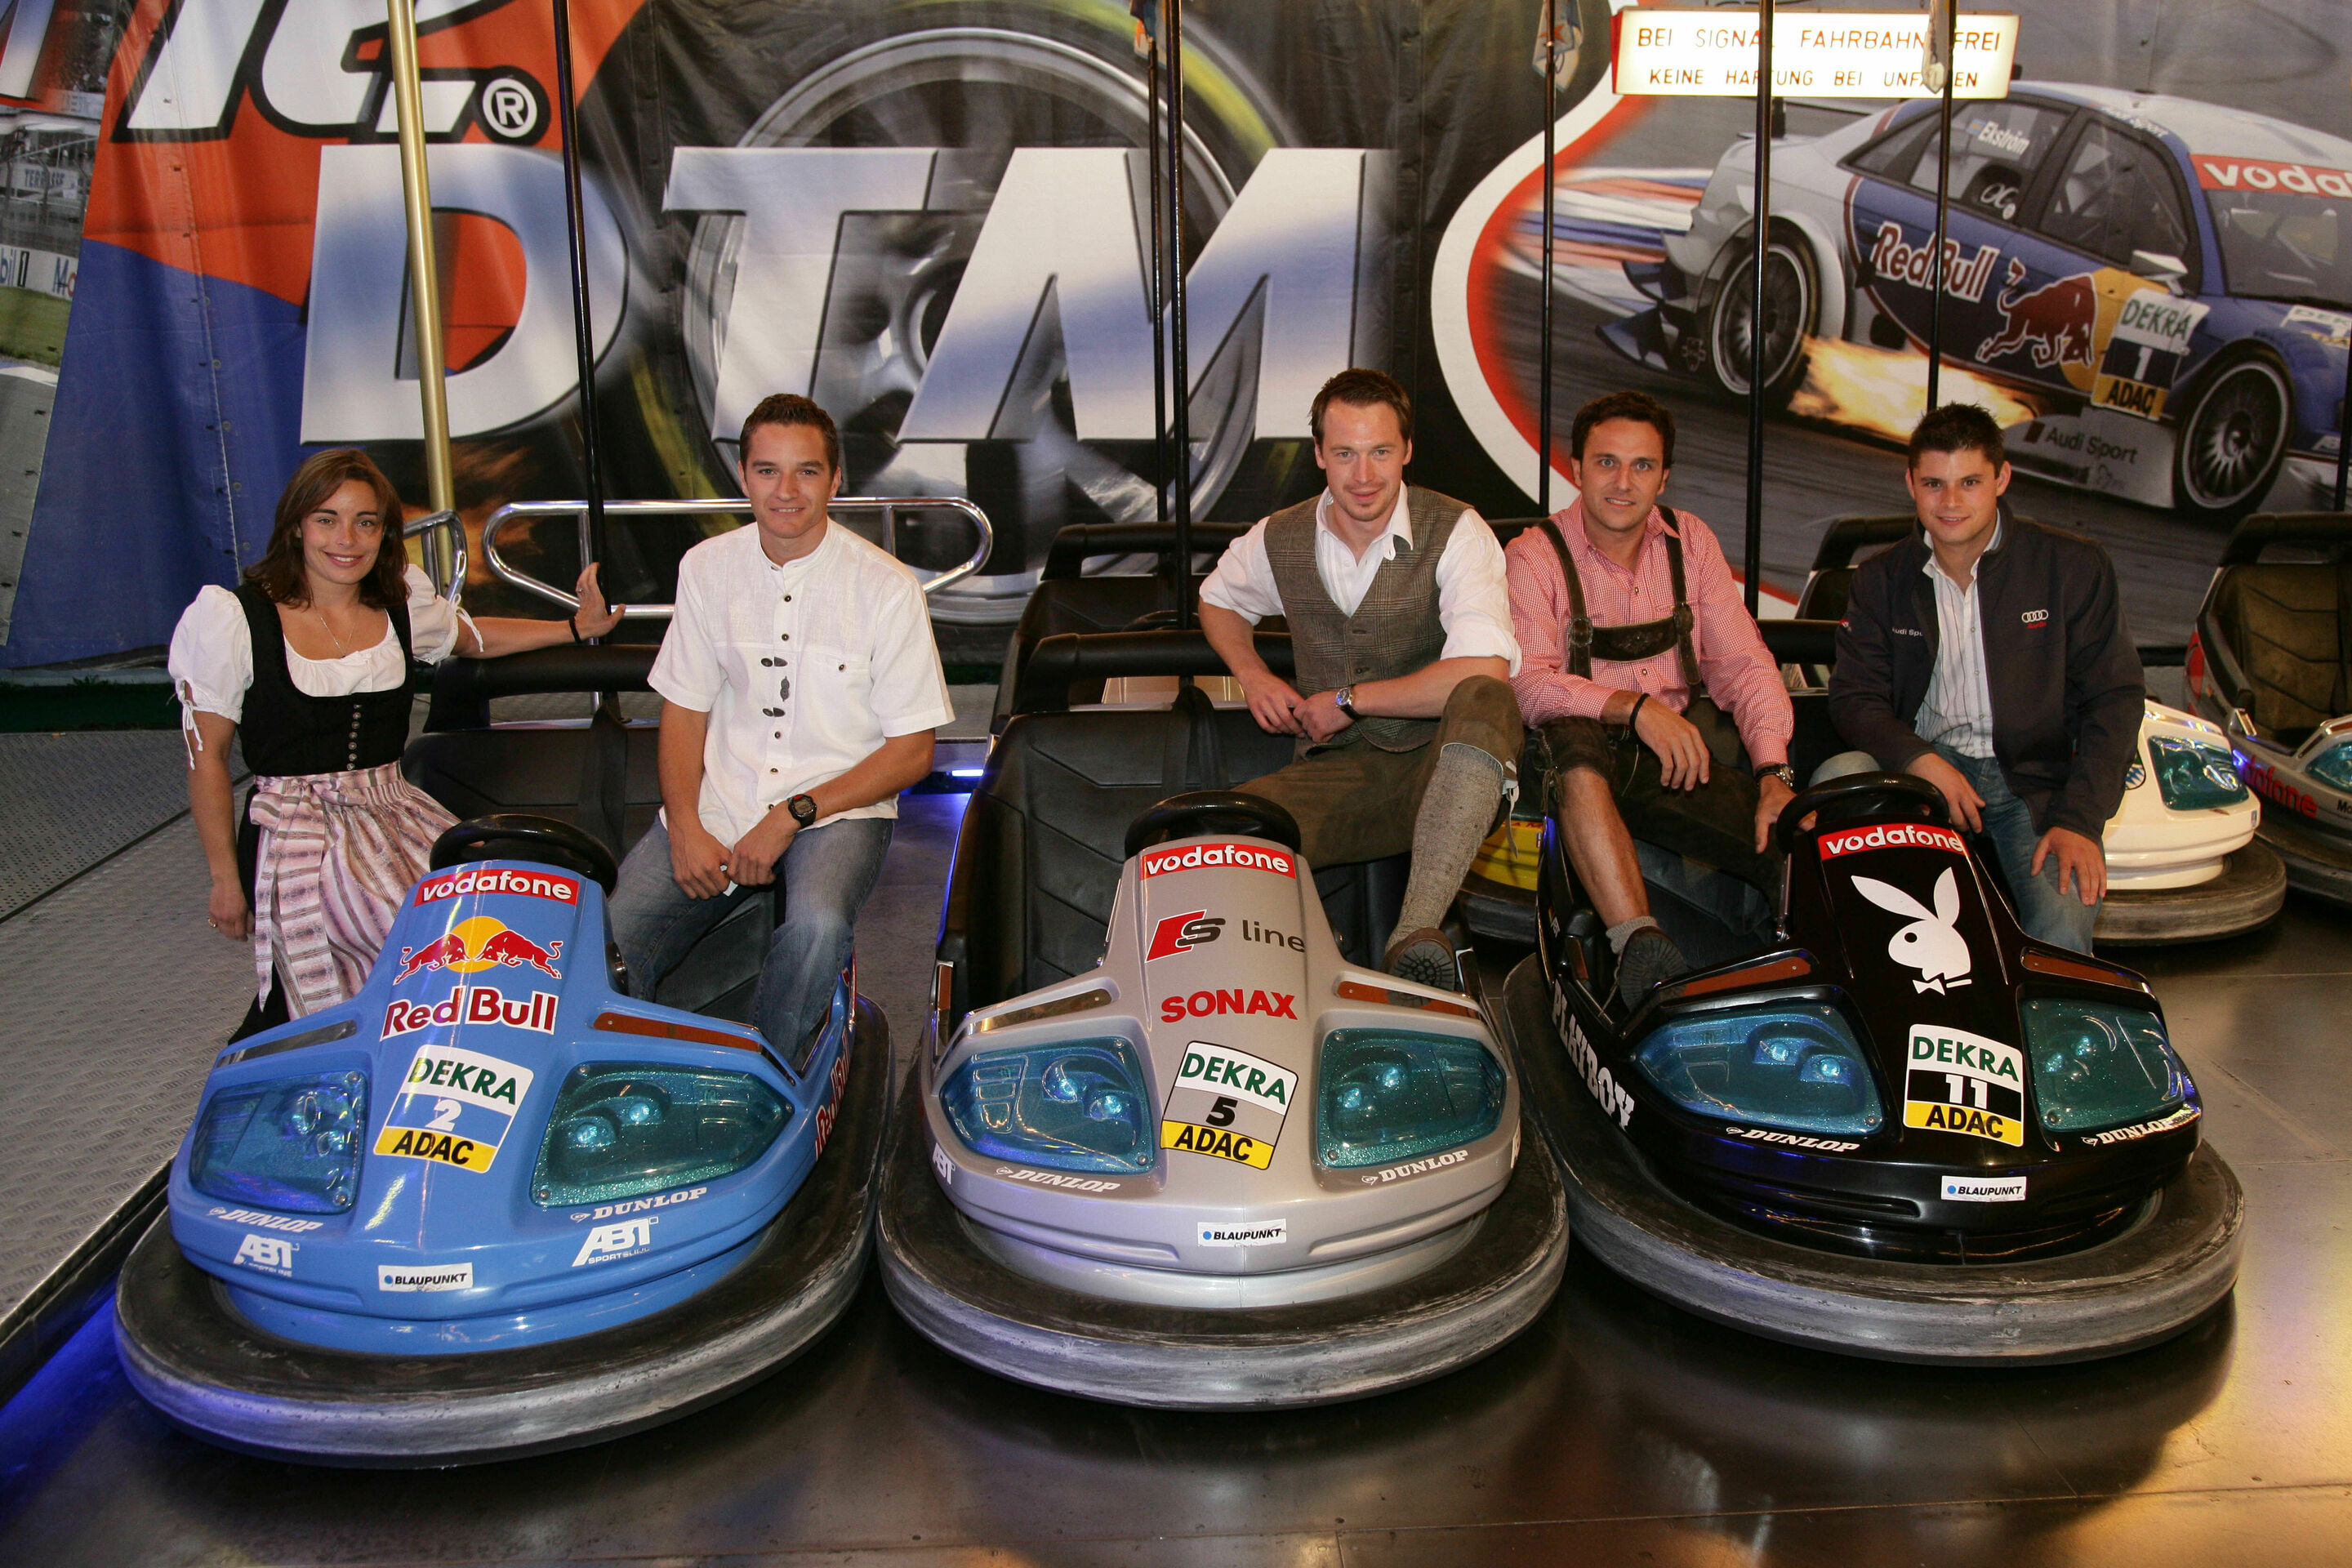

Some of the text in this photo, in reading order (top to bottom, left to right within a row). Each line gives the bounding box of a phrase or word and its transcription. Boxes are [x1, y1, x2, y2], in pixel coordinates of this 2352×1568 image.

[1638, 28, 1672, 47] BEI
[1695, 28, 1775, 48] SIGNA
[1953, 32, 2000, 51] FREI
[1650, 69, 1704, 85] KEINE
[1726, 69, 1813, 86] HAFUNG
[1834, 70, 1862, 87] BEI
[1977, 121, 2030, 155] Ekström
[300, 144, 1365, 445] DTM
[2121, 299, 2193, 341] DEKRA
[2134, 345, 2154, 382] 1
[2105, 380, 2157, 414] ADAC
[2047, 427, 2138, 464] Audi Sport
[1826, 825, 1964, 854] vodafone
[1147, 844, 1290, 875] vodafone
[423, 871, 572, 902] vodafone
[1242, 920, 1306, 953] line
[380, 985, 559, 1042] Red Bull
[1160, 989, 1298, 1022] SONAX
[1912, 1036, 2020, 1083] DEKRA
[408, 1057, 516, 1105] DEKRA
[1181, 1053, 1285, 1106] DEKRA
[1945, 1073, 1988, 1110] 11
[425, 1099, 462, 1132] 2
[1205, 1096, 1238, 1127] 5
[1925, 1105, 2003, 1138] ADAC
[391, 1130, 474, 1165] ADAC
[1174, 1125, 1253, 1161] ADAC
[1740, 1129, 1860, 1152] DUNLOP
[2096, 1118, 2173, 1144] DUNLOP
[1009, 1169, 1120, 1192] DUNLOP
[1378, 1150, 1469, 1183] DUNLOP
[592, 1187, 708, 1220] DUNLOP
[1958, 1186, 2022, 1196] BLAUPUNKT
[217, 1209, 323, 1233] DUNLOP
[1214, 1228, 1281, 1241] BLAUPUNKT
[234, 1234, 292, 1268] ABT
[572, 1218, 650, 1267] ABT
[394, 1272, 468, 1285] BLAUPUNKT
